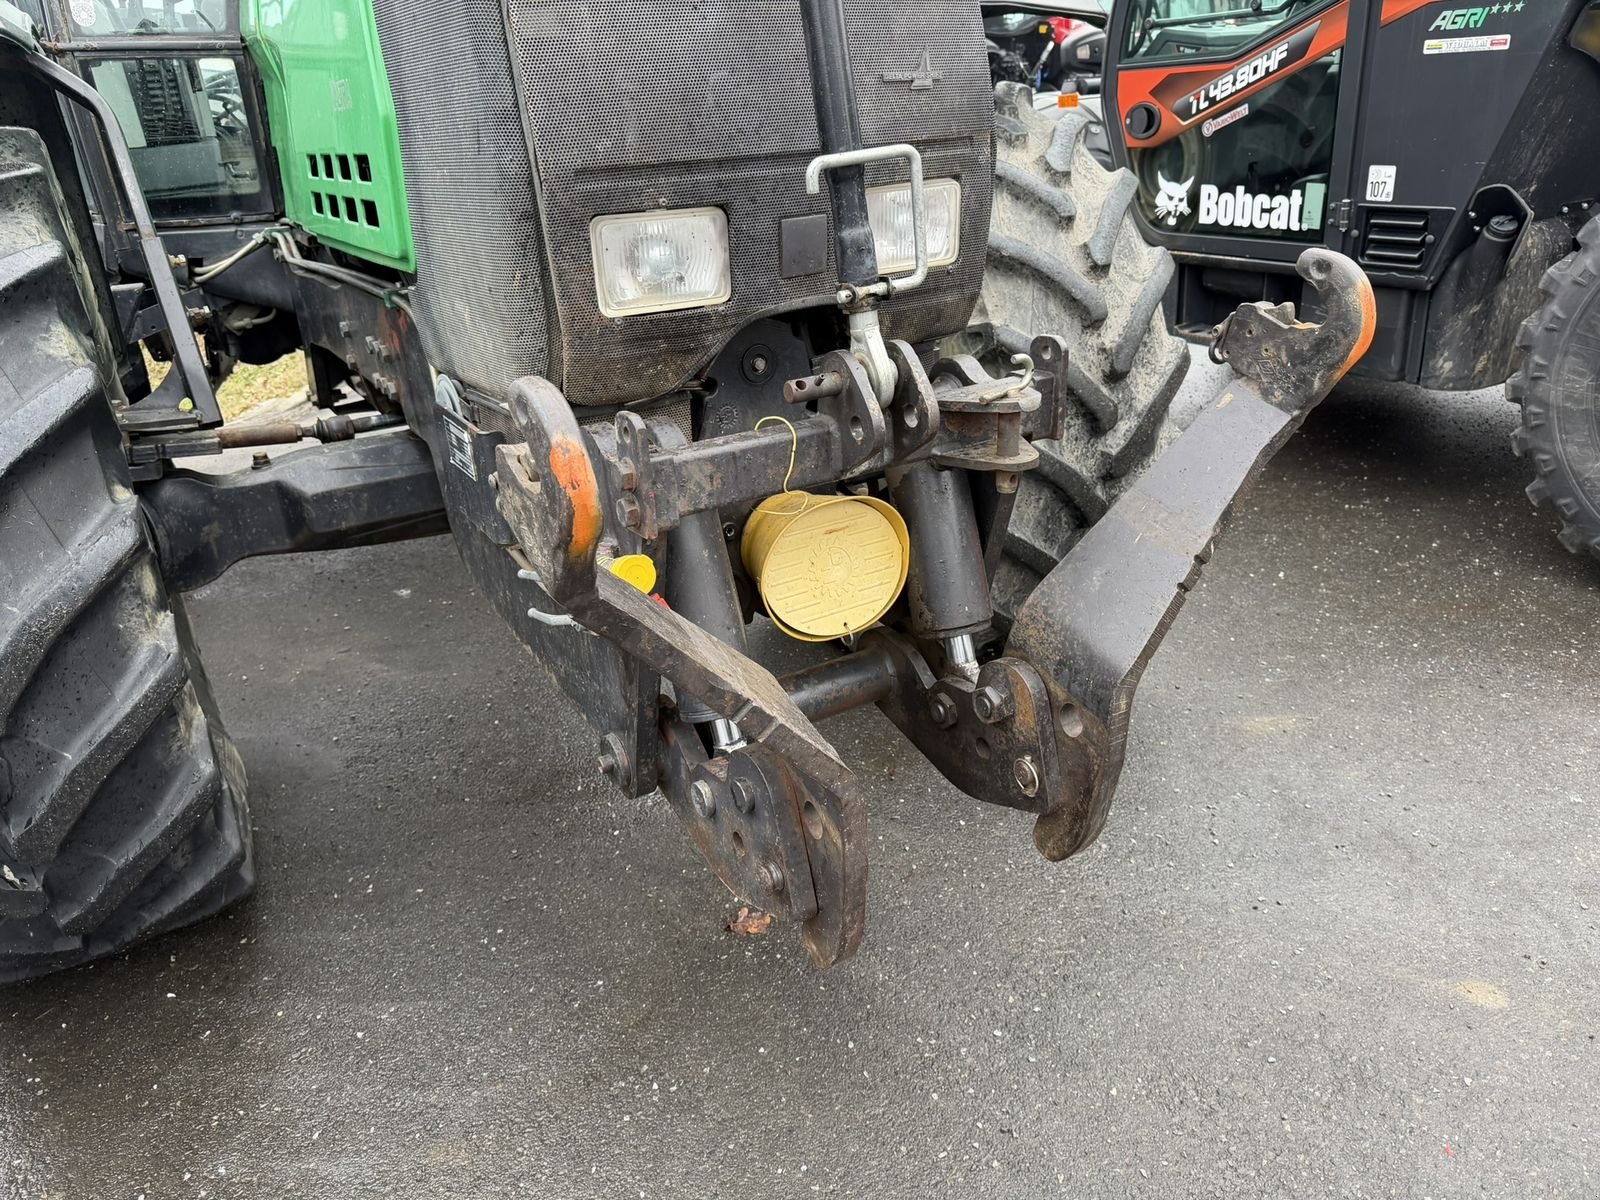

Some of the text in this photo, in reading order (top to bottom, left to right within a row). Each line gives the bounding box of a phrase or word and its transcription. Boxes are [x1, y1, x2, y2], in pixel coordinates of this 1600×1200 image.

[1428, 7, 1489, 31] AGRI
[1369, 181, 1387, 198] 107
[1198, 184, 1302, 231] Bobcat
